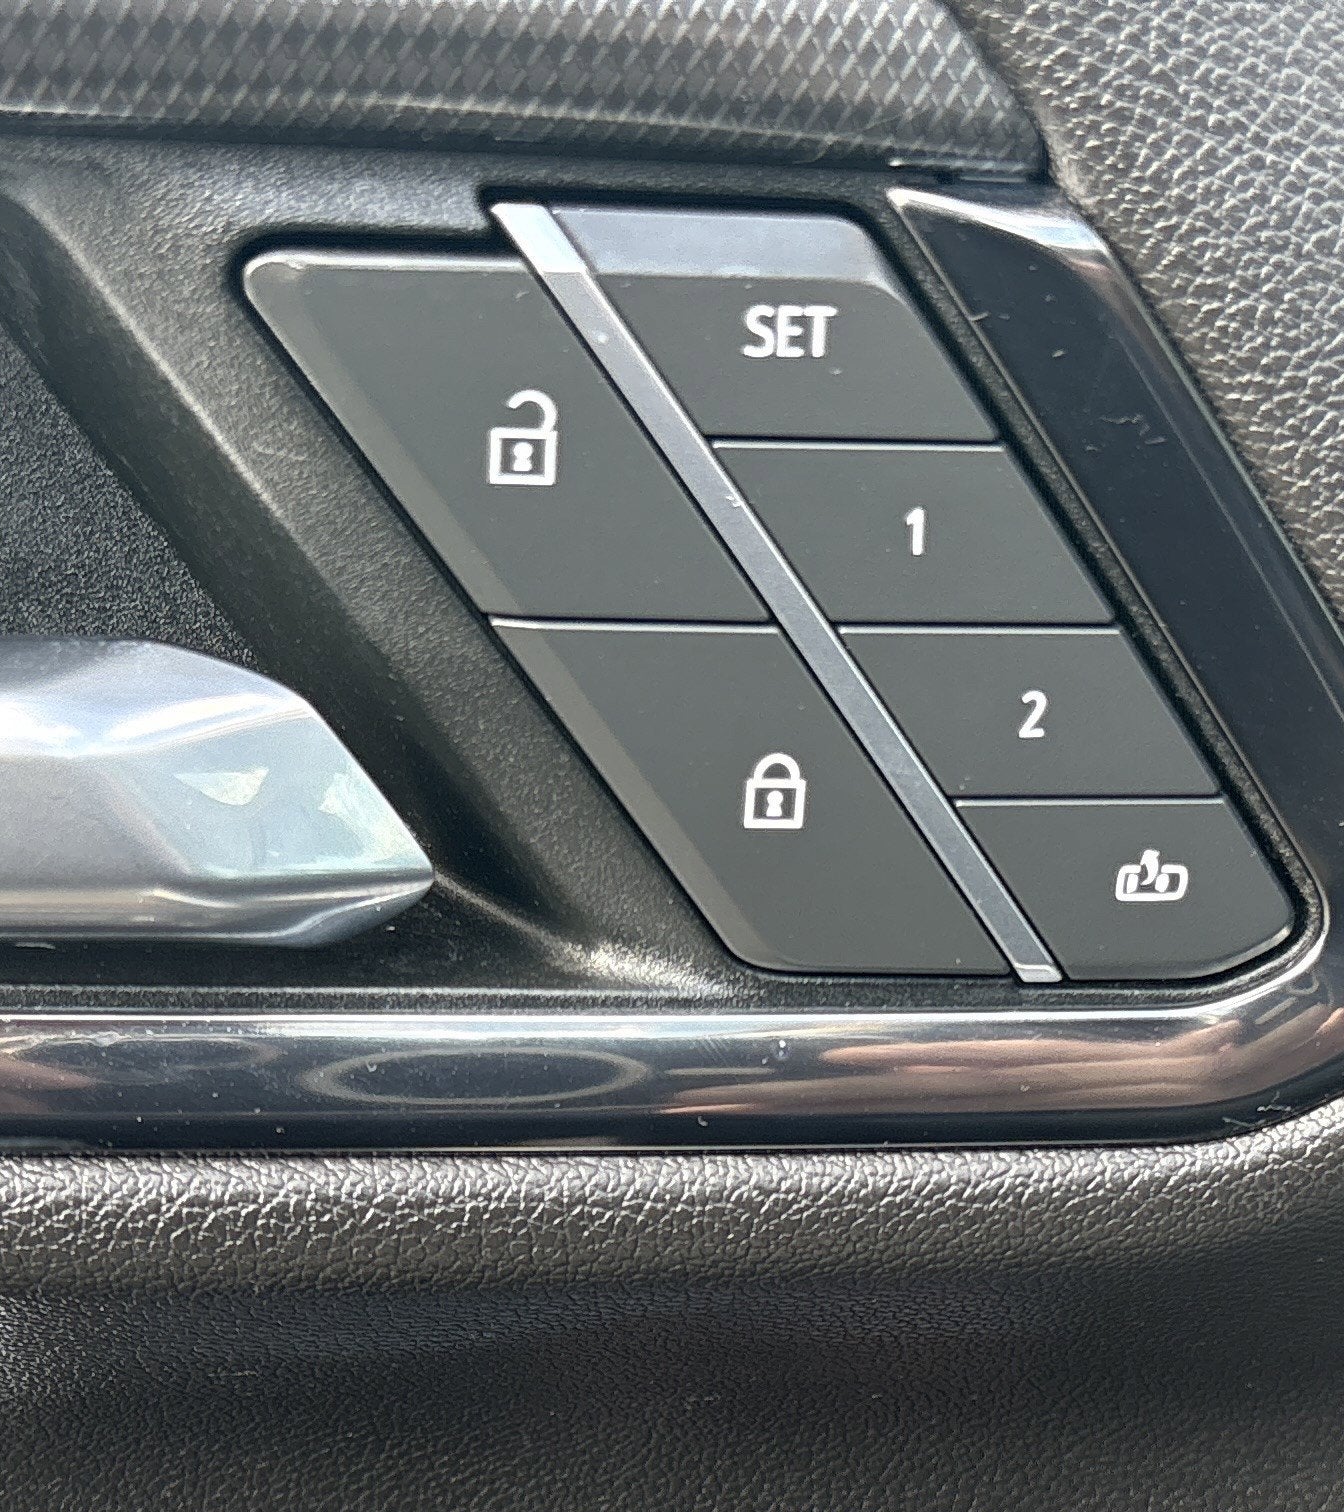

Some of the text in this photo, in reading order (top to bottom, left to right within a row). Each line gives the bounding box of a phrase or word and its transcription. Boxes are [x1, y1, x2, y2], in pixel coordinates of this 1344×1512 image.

[742, 304, 838, 358] SET
[905, 506, 925, 556] 1
[1018, 689, 1048, 739] 2
